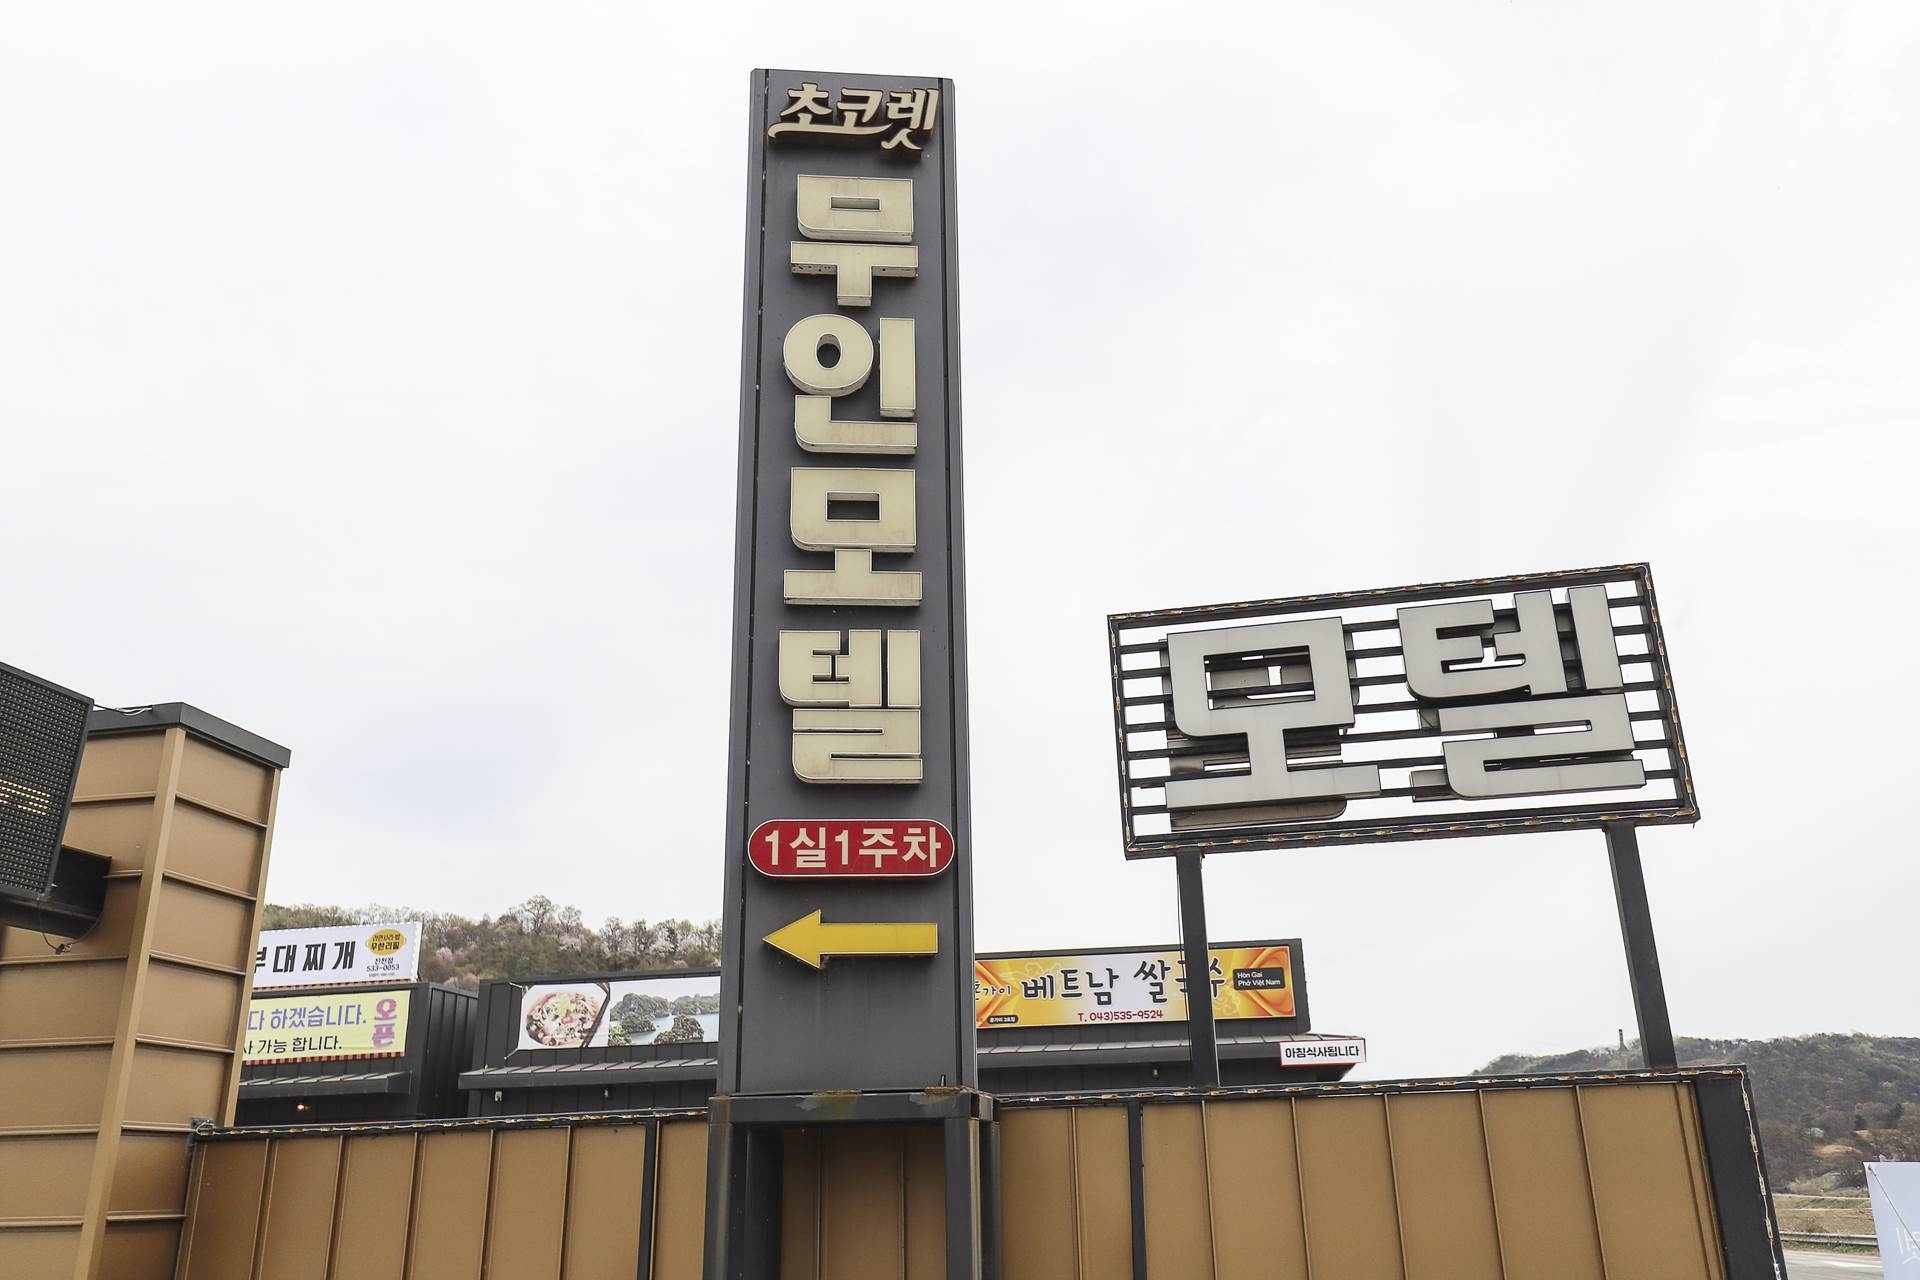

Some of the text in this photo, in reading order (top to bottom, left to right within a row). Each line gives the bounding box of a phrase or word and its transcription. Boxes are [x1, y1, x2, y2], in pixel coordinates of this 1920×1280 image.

[779, 174, 923, 785] 무인모텔
[1163, 584, 1647, 812] 모텔
[764, 825, 943, 869] 1실1주차
[1021, 967, 1120, 1006] 베트남
[270, 1004, 367, 1029] 하겠습니다.
[373, 998, 397, 1047] 오픈
[257, 1039, 288, 1055] 가능
[292, 1035, 342, 1053] 합니다.
[1285, 1045, 1360, 1058] 아침식사됩니다
